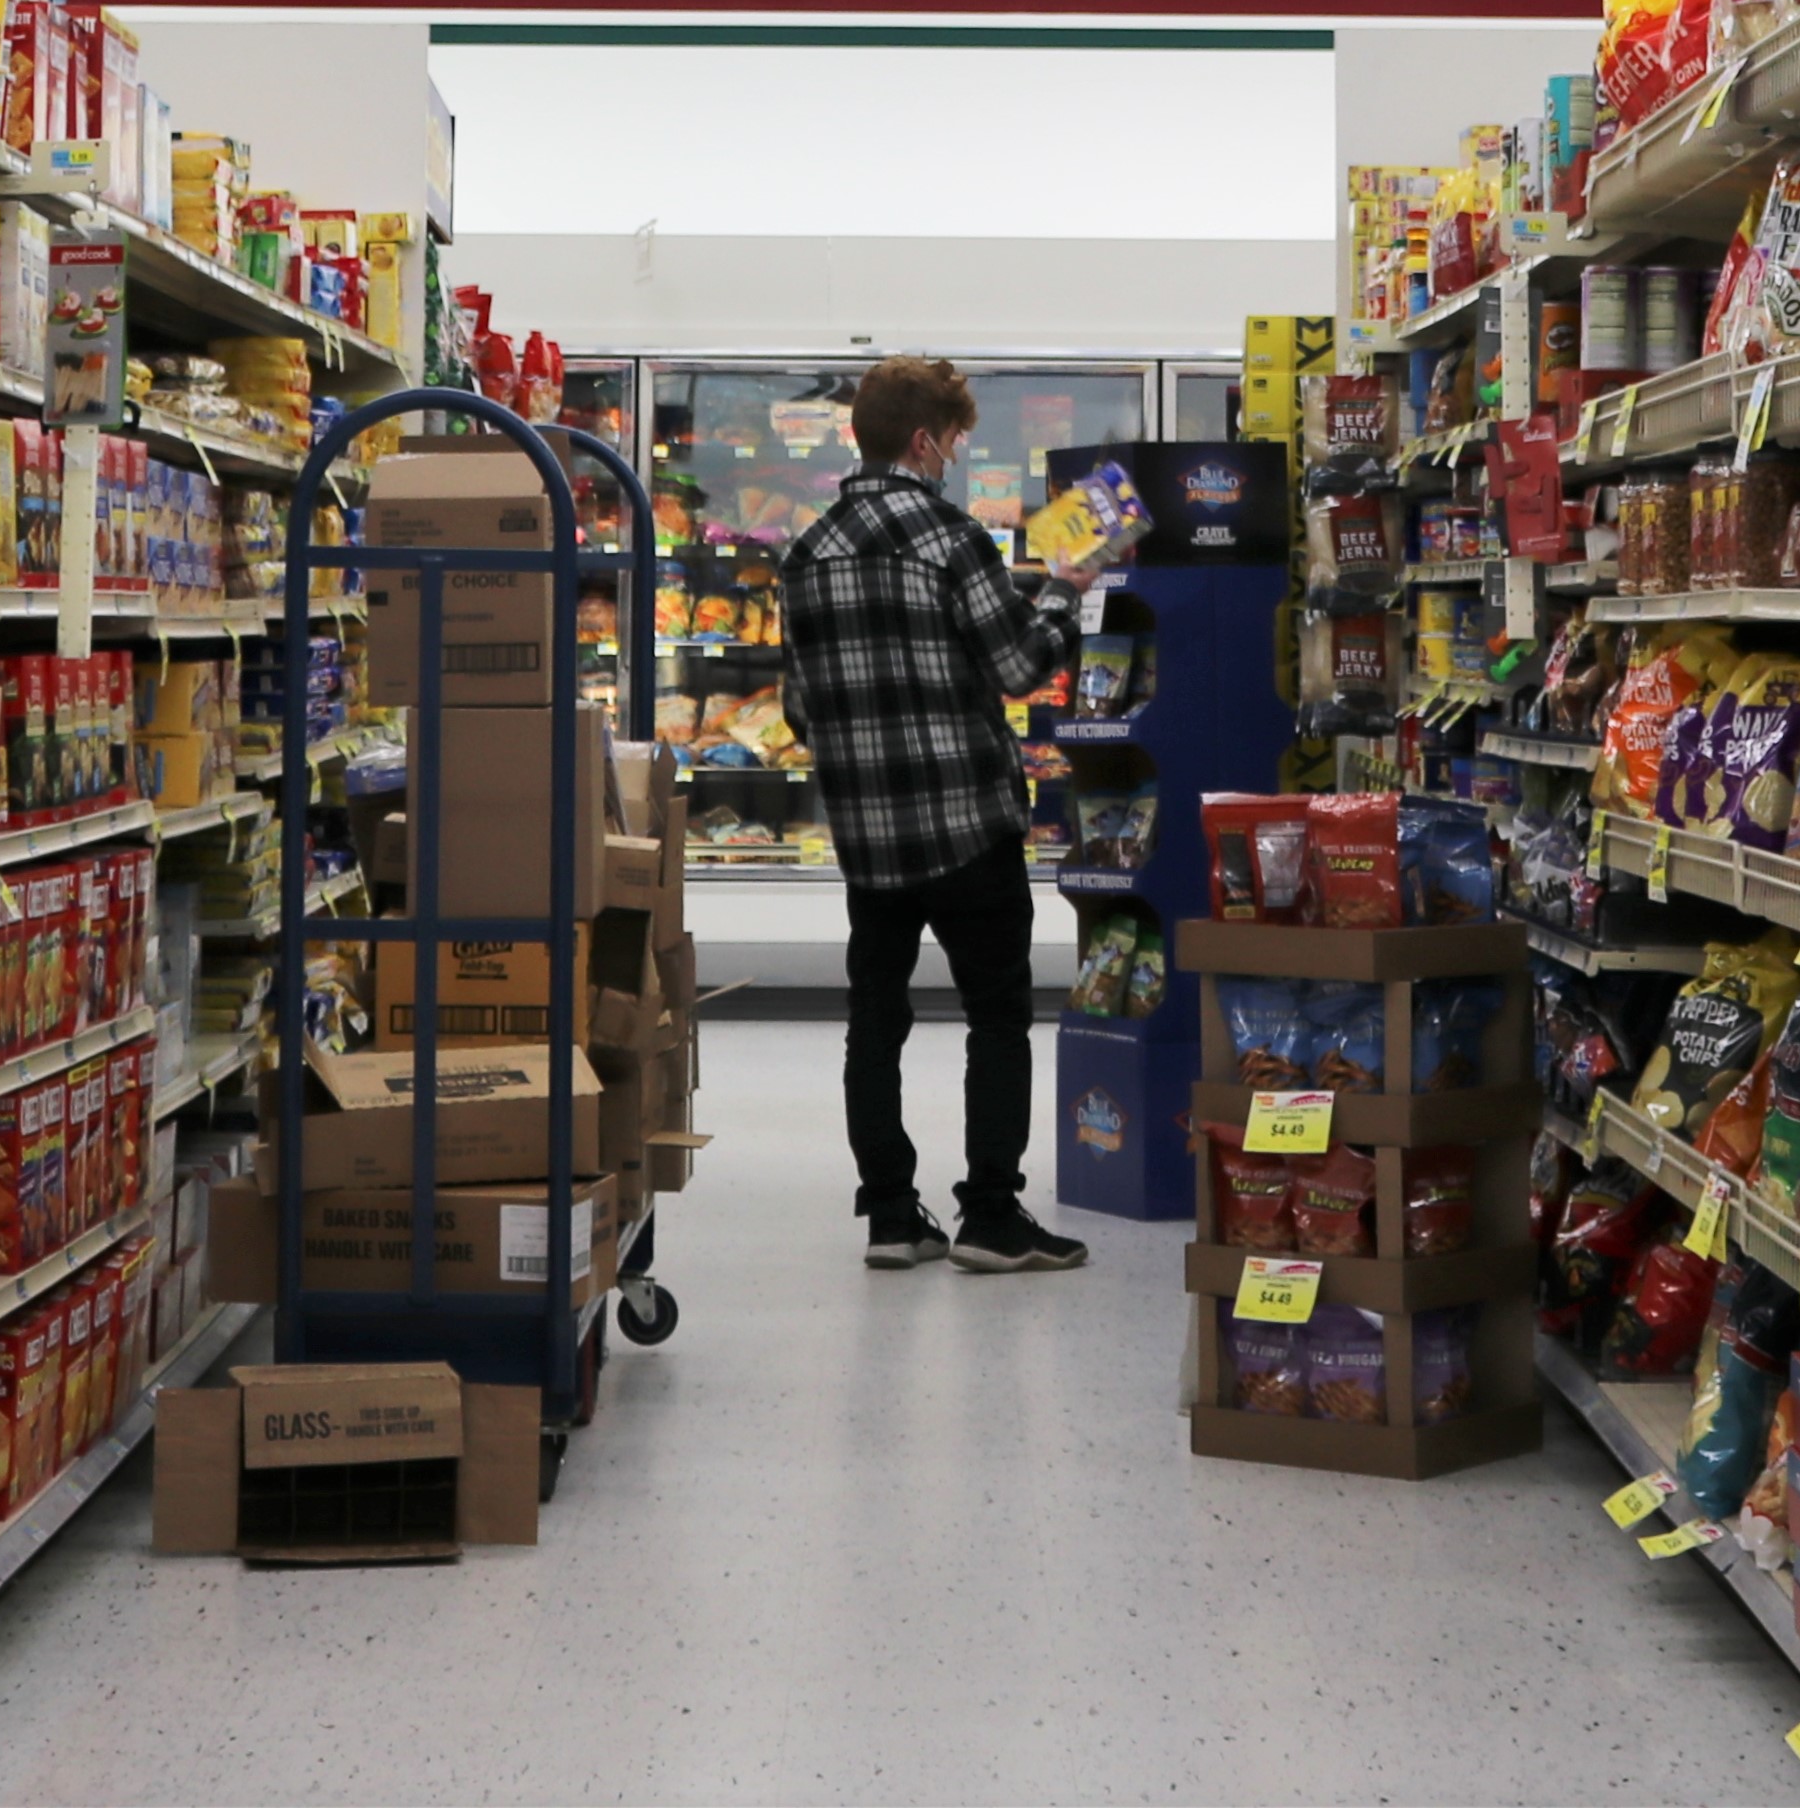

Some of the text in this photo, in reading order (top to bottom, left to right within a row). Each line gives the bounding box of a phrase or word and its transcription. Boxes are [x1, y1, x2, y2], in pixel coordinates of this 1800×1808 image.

[1334, 414, 1375, 428] BEEF
[1331, 424, 1379, 442] JERKY
[1340, 532, 1376, 545] BEEF
[1337, 545, 1383, 561] JERKY
[452, 574, 518, 589] CHOICE
[1341, 650, 1377, 663] BEEF
[1336, 662, 1382, 677] JERKY
[1680, 1049, 1721, 1067] CHIPS
[1271, 1123, 1304, 1137] $4.49
[323, 1209, 380, 1229] BAKED
[305, 1241, 371, 1260] HANDLE
[1260, 1292, 1291, 1305] $4.49
